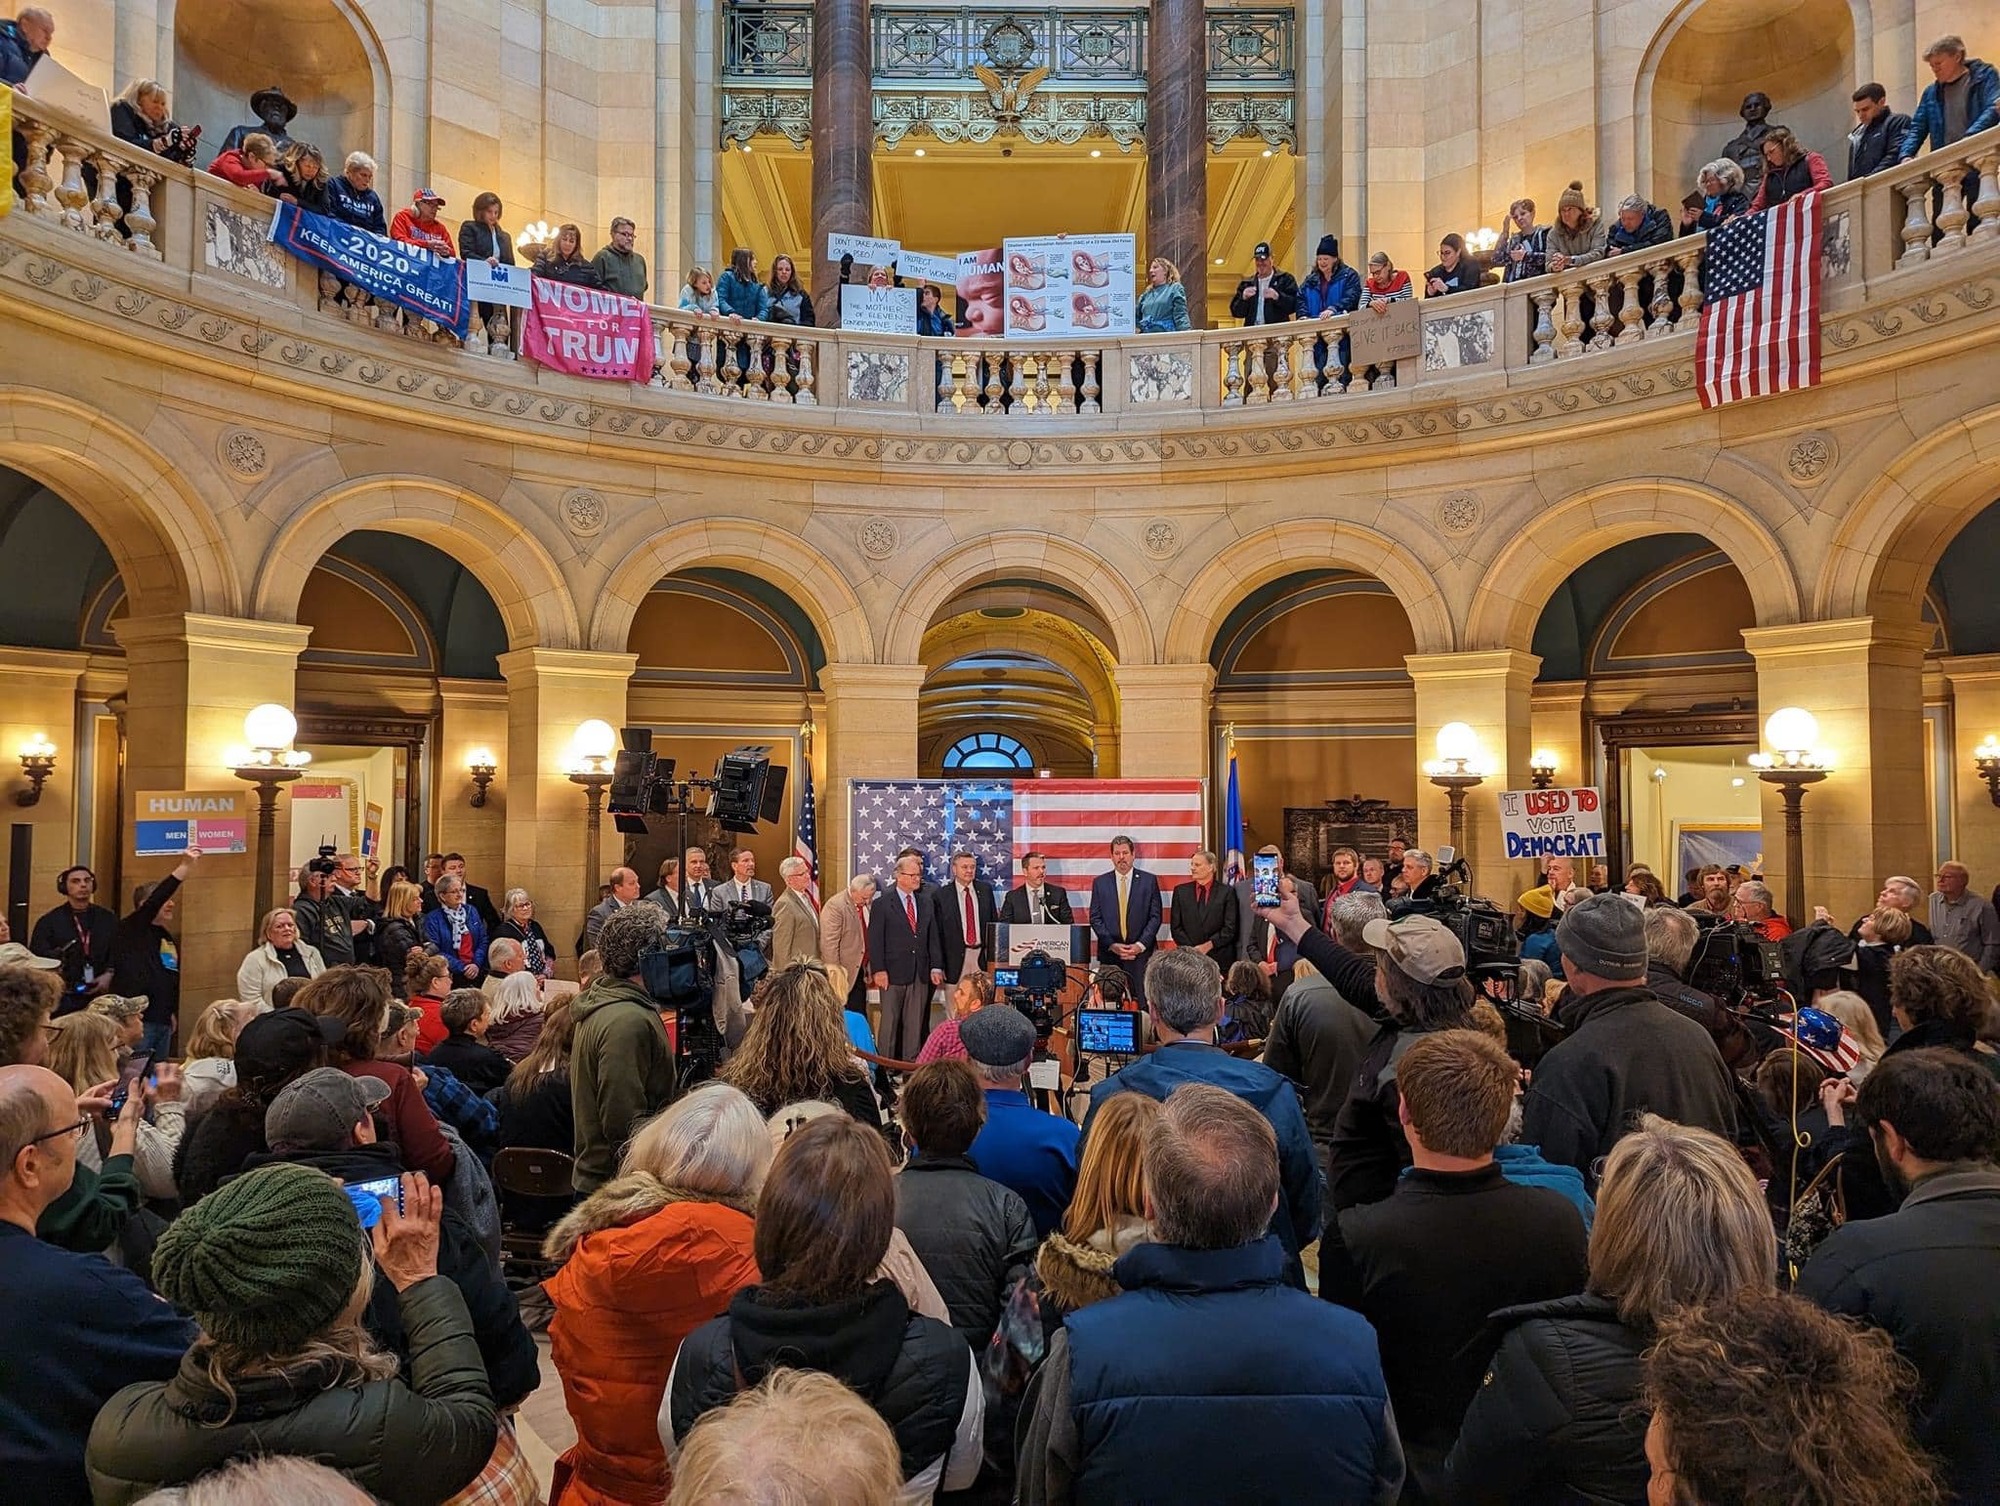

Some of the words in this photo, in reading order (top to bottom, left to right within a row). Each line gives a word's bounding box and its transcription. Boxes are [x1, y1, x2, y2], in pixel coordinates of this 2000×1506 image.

[834, 237, 850, 246] DON'T
[872, 241, 893, 250] AWAY
[904, 254, 932, 266] PROTECT
[963, 257, 977, 265] AM
[300, 228, 336, 255] KEEP
[338, 253, 402, 288] AMERICA
[405, 283, 453, 313] GREAT!
[909, 264, 927, 274] TINY
[929, 269, 957, 280] WOME
[534, 280, 646, 318] WOME
[869, 289, 888, 302] I'M
[866, 304, 903, 313] MOTHER
[587, 319, 620, 333] FOR
[1352, 328, 1375, 348] GIVE
[1382, 326, 1393, 341] IT
[1395, 321, 1419, 336] BACK
[543, 326, 640, 365] TRUM
[150, 797, 235, 813] HUMAN
[1504, 794, 1518, 816] I
[1524, 790, 1569, 816] USED
[1572, 789, 1598, 812] TO
[1527, 815, 1576, 834] VOTE
[1507, 832, 1602, 858] DEMOCRAT
